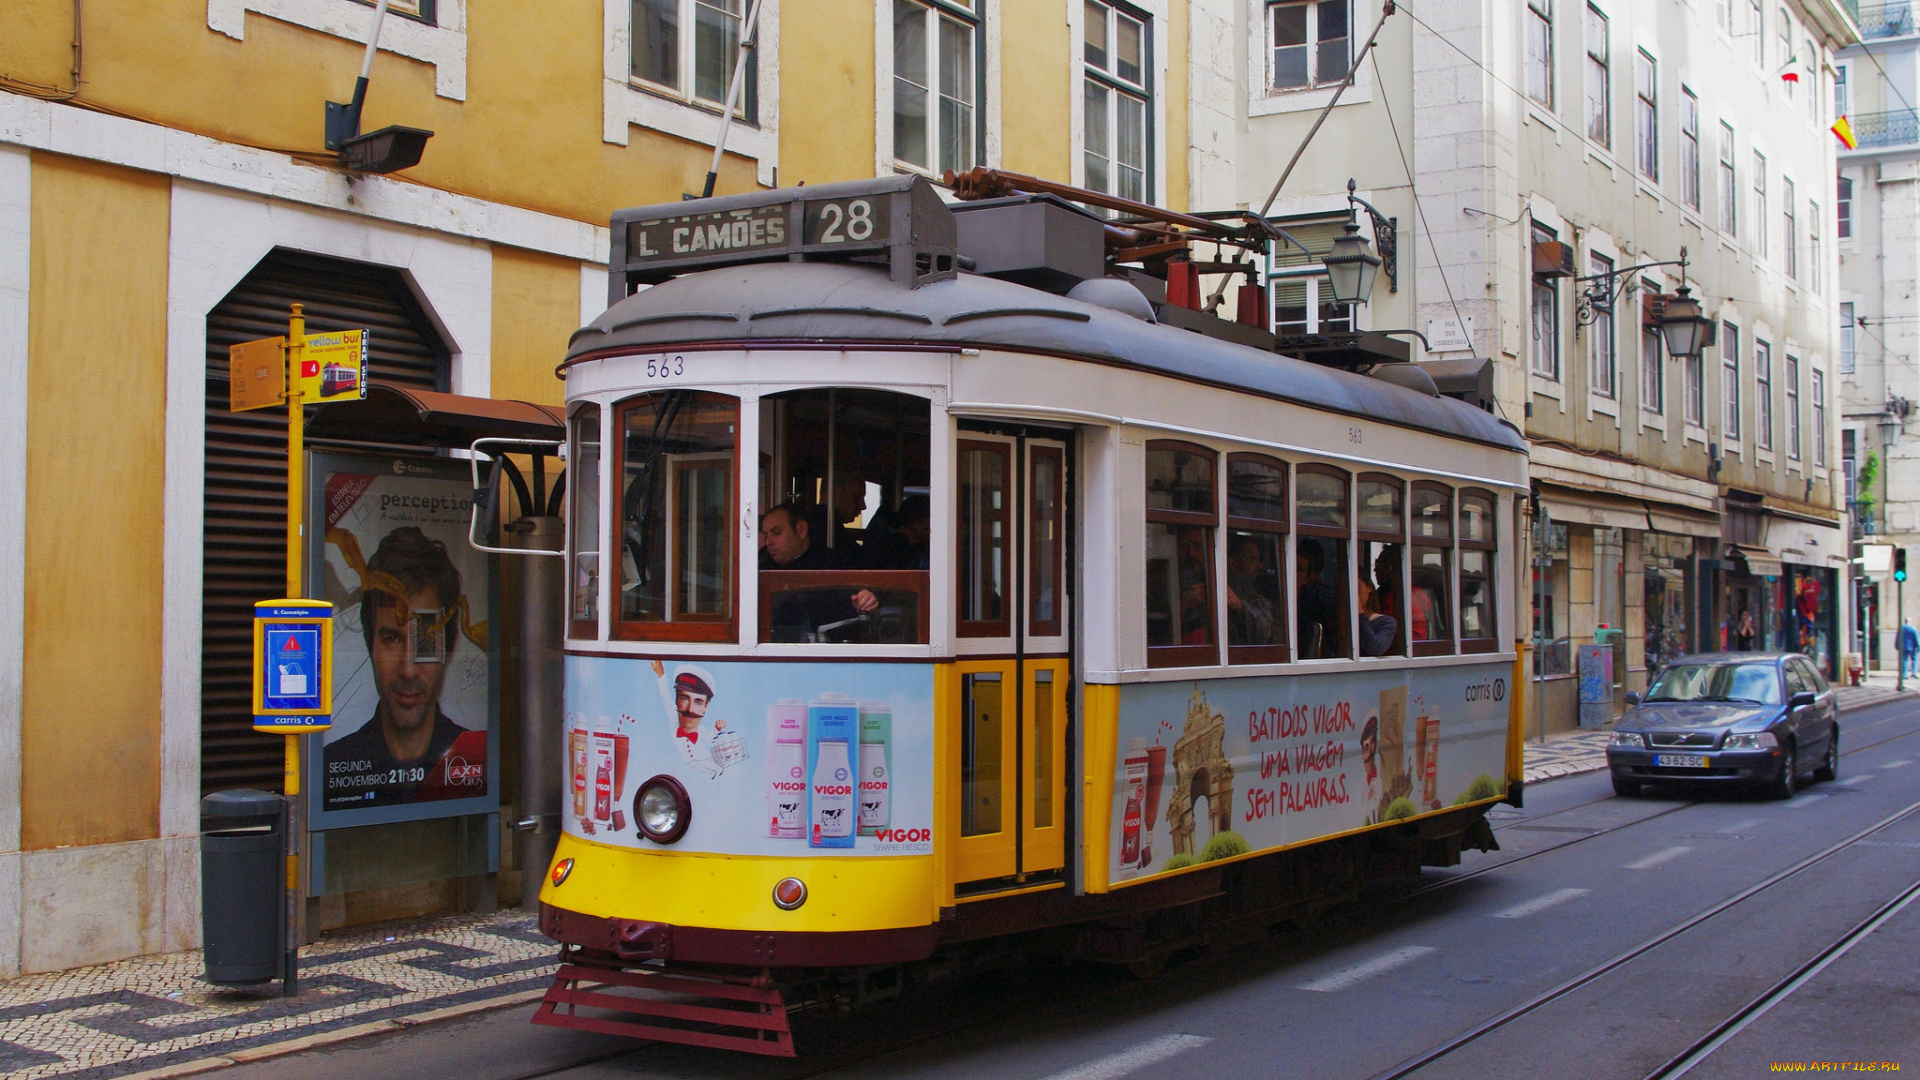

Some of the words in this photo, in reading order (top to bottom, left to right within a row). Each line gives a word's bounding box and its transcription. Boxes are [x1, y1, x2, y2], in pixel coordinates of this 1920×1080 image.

[820, 199, 874, 244] 28
[639, 231, 659, 257] L.
[672, 215, 785, 254] CAMÕES
[308, 335, 342, 348] yellow
[343, 333, 360, 344] bus
[311, 364, 316, 373] 4
[647, 355, 684, 378] 563
[1348, 427, 1362, 444] 563
[332, 479, 356, 507] ESTREIA
[1465, 677, 1491, 702] carris
[275, 716, 302, 724] carris
[1249, 704, 1308, 743] BATIDOS
[329, 760, 372, 774] SEGUNDA
[1260, 748, 1291, 780] UMA
[1296, 740, 1344, 775] VIAGEM
[1660, 756, 1671, 766] 43
[1673, 756, 1685, 766] 62
[329, 777, 336, 789] 5
[335, 773, 388, 789] NOVEMBRO
[388, 767, 425, 784] 21h30
[451, 766, 482, 778] AXN
[773, 782, 806, 791] VIGOR
[815, 785, 852, 795] VIGOR
[1245, 788, 1275, 822] SEM
[1124, 817, 1141, 827] VIGOR
[874, 828, 931, 842] VIGOR
[902, 843, 930, 851] FRESCO
